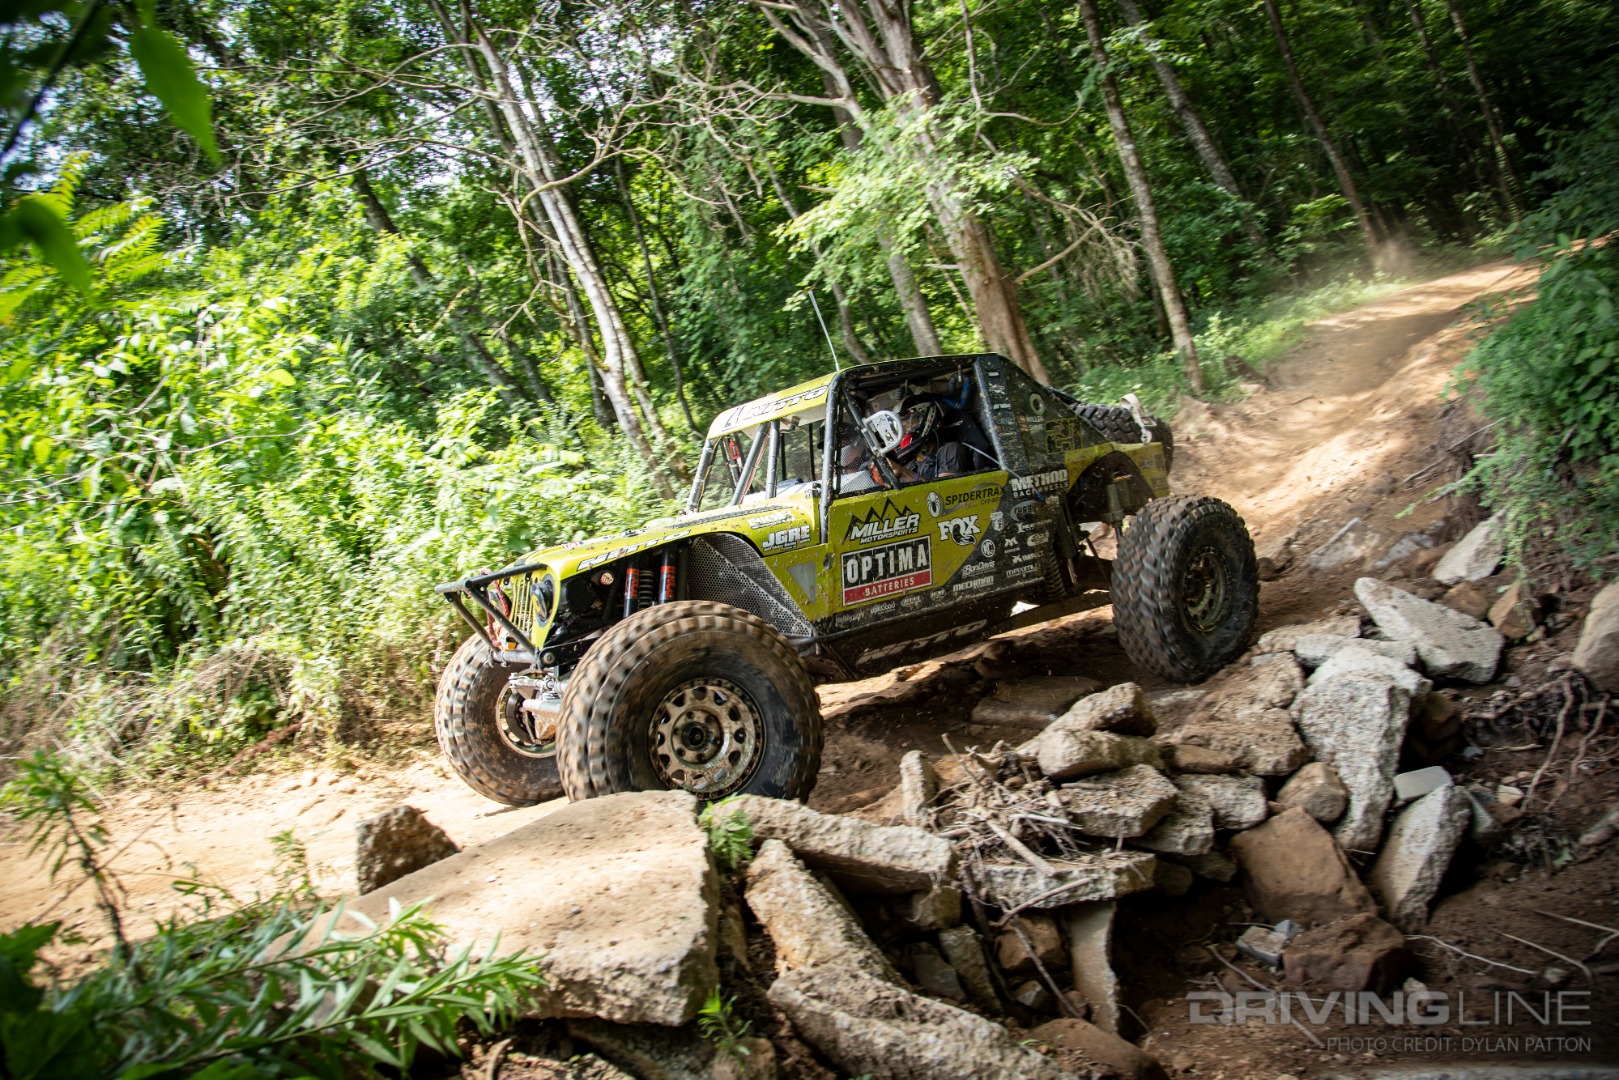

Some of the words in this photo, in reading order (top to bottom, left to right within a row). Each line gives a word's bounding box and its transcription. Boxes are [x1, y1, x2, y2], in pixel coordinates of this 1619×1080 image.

[1009, 469, 1068, 492] METHOD
[762, 524, 811, 549] JGRE
[850, 513, 921, 540] MILLER
[859, 526, 919, 545] MOTORSPORTS
[937, 514, 981, 546] FOX
[846, 543, 928, 585] OPTIMA
[864, 577, 915, 597] BATTERIES
